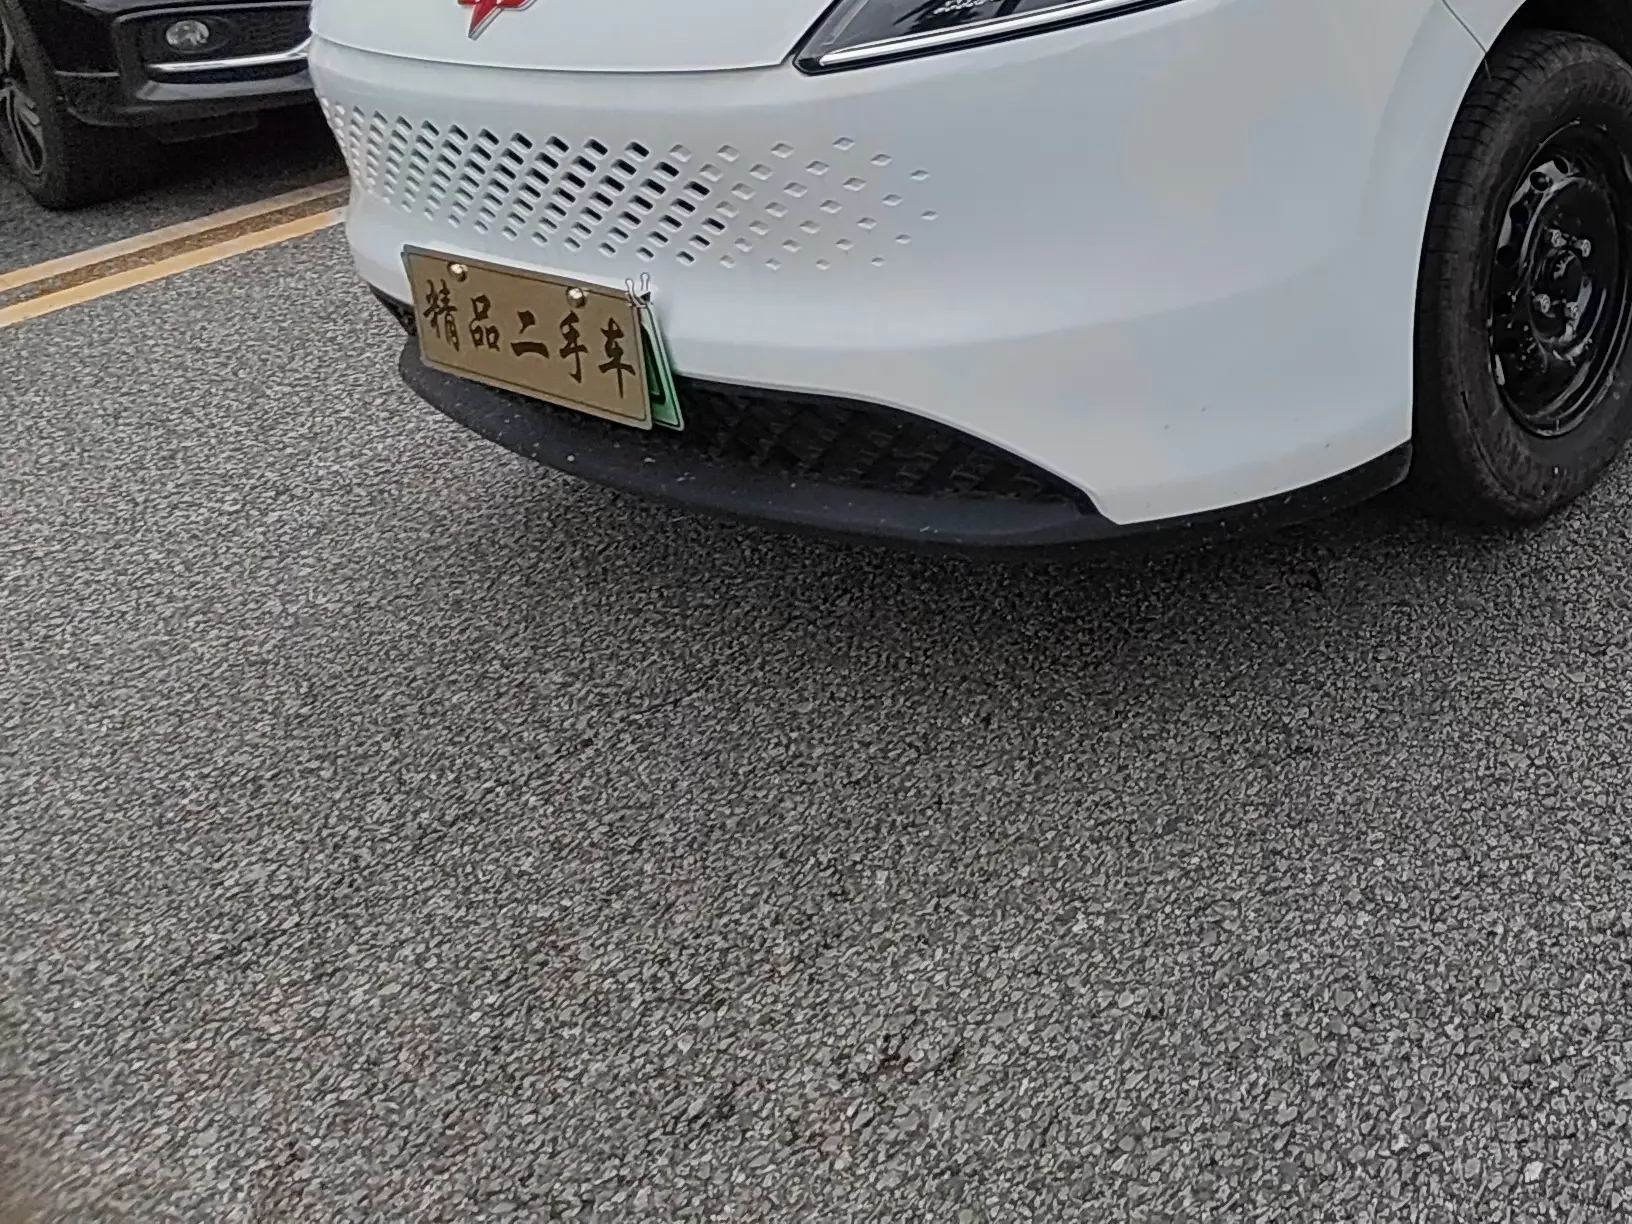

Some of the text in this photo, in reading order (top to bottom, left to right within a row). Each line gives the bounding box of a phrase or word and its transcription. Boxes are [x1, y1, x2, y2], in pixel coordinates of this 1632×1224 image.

[423, 279, 636, 400] 精品二手车
